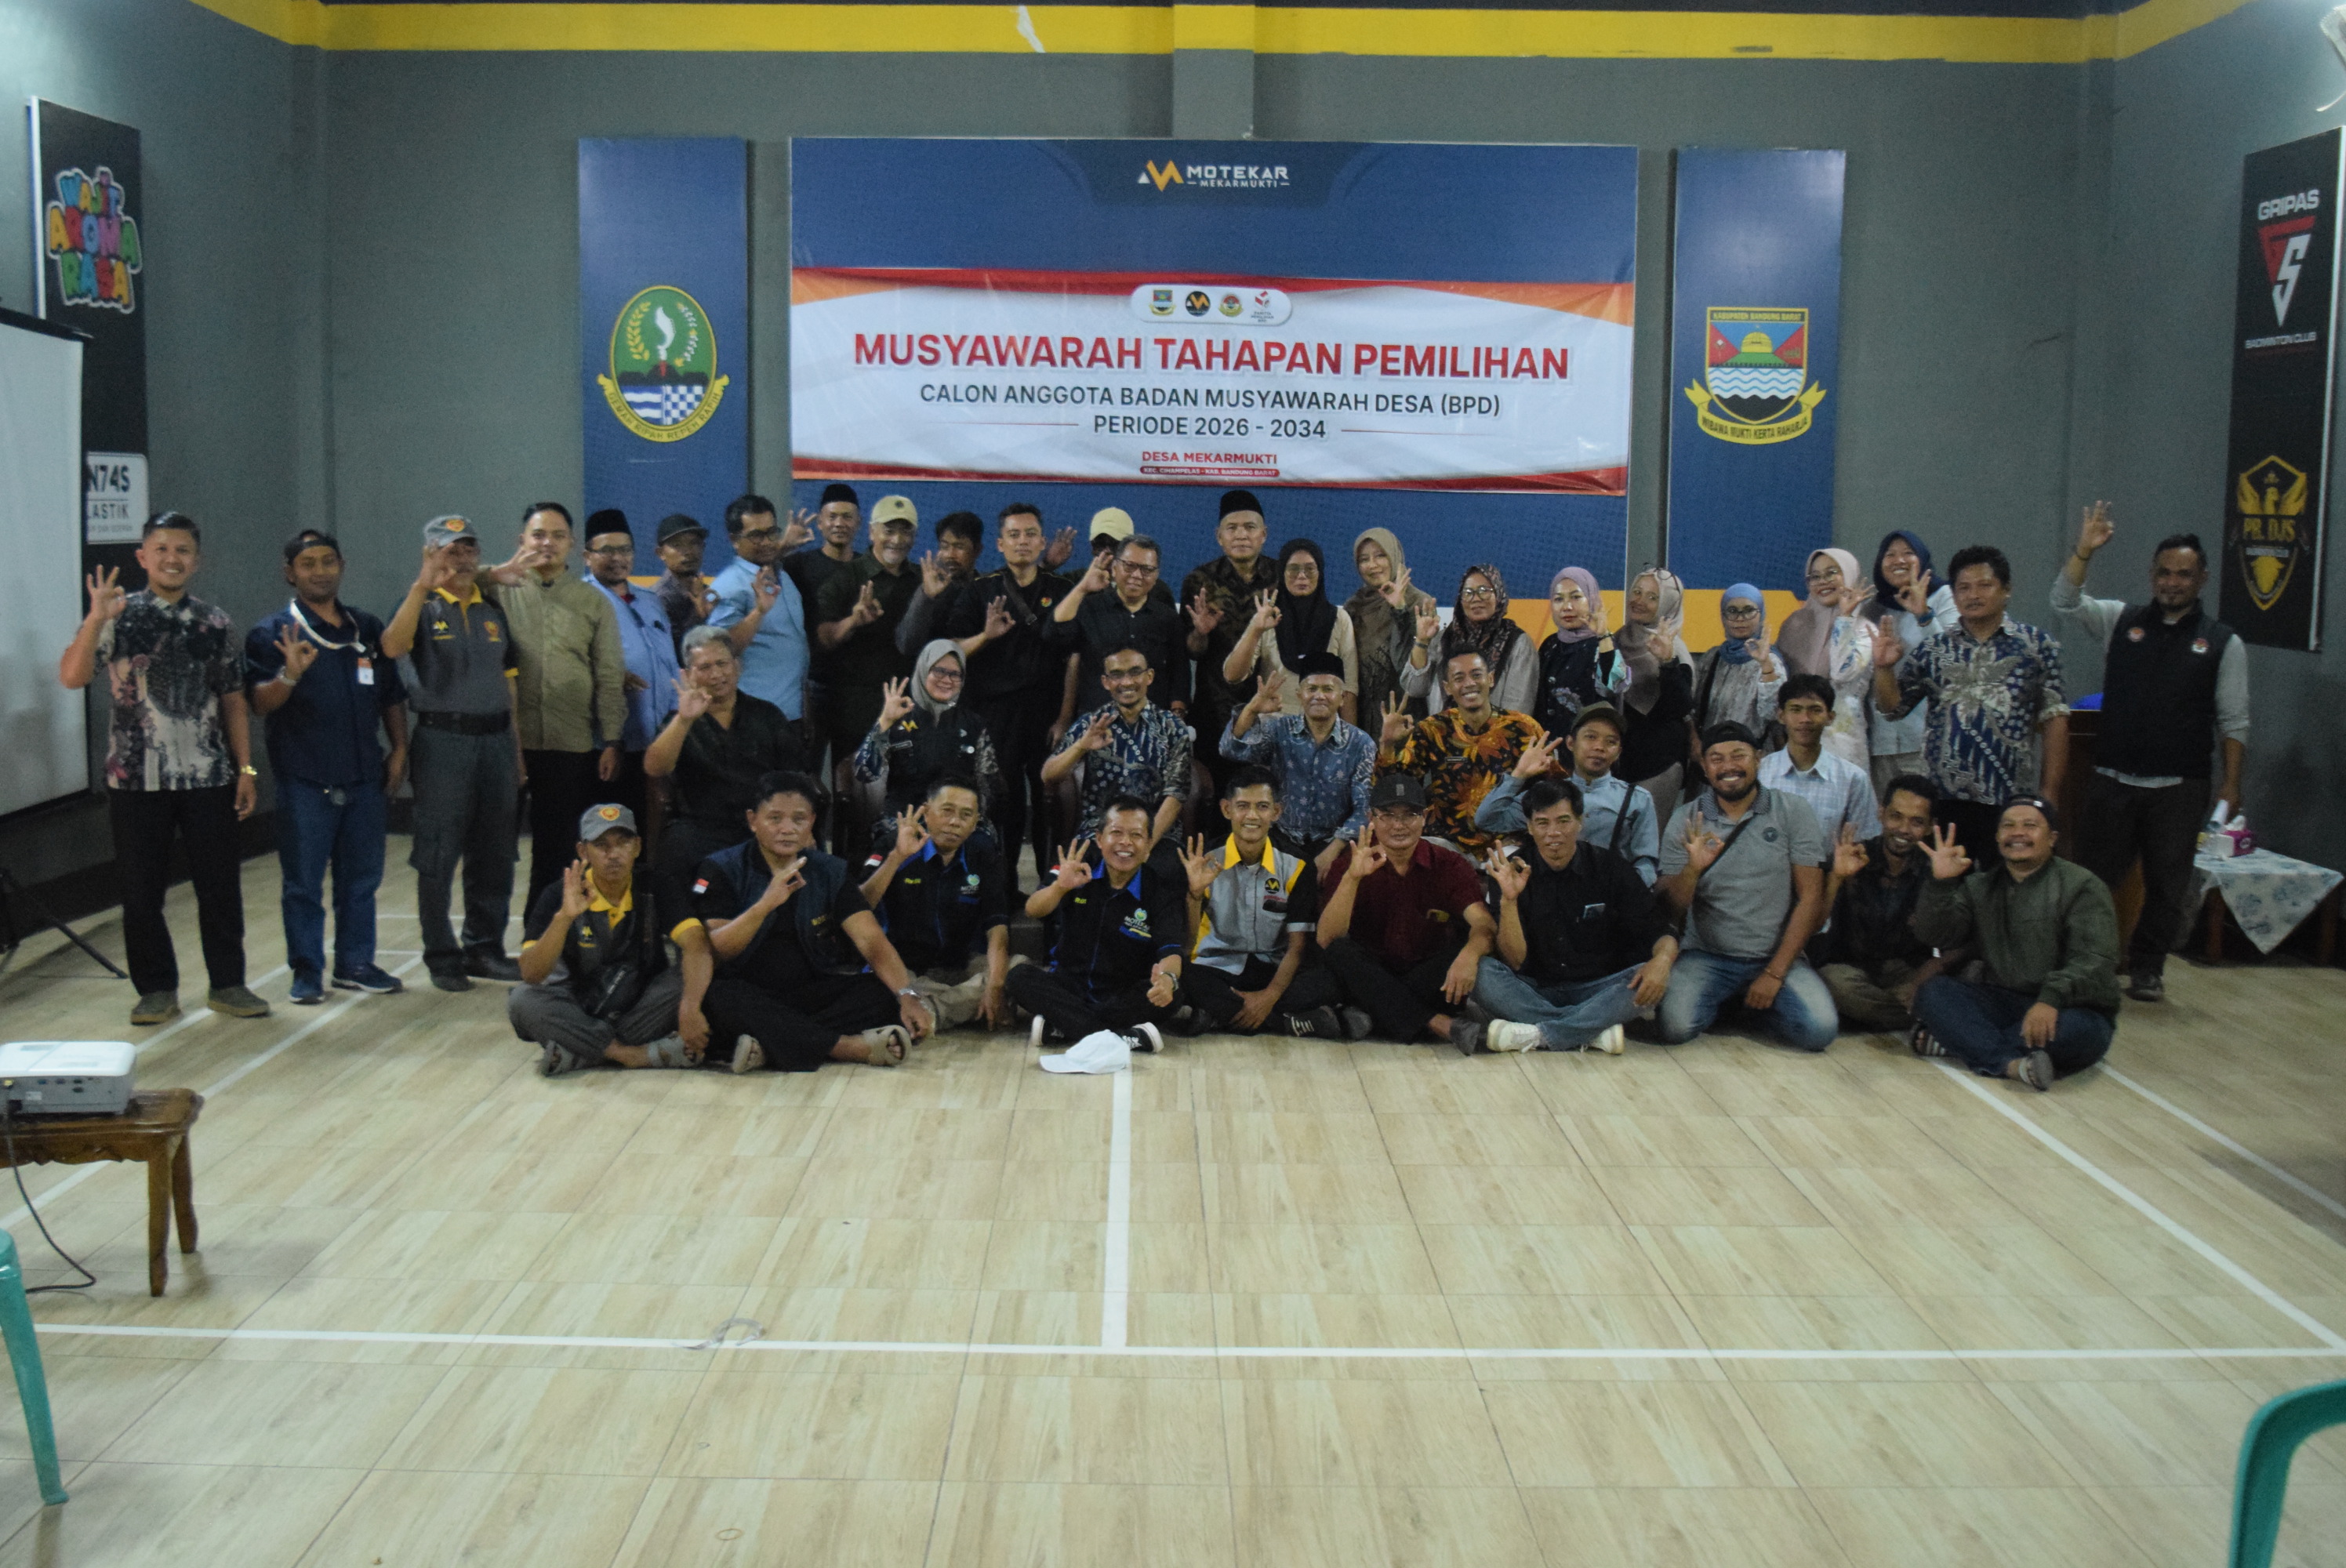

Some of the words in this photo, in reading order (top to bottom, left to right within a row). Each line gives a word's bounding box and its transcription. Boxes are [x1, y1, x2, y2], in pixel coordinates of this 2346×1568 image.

[1186, 165, 1289, 180] MOTEKAR
[1200, 180, 1277, 188] MEKARMUKTI
[2257, 189, 2319, 220] GRIPAS
[50, 205, 139, 267] AROMA
[60, 251, 129, 305] RASA
[855, 333, 1142, 368] MUSYAWARAH
[1154, 338, 1342, 372] TAHAPAN
[1354, 343, 1568, 379] PEMILIHAN
[921, 384, 997, 403] CALON
[1004, 385, 1113, 405] ANGGOTA
[1121, 388, 1198, 407] BADAN
[1206, 389, 1368, 412] MUSYAWARAH
[1375, 394, 1434, 414] DESA
[1441, 394, 1501, 417] (BPD)
[1095, 416, 1188, 435] PERIODE
[1194, 418, 1249, 437] 2026
[1270, 419, 1326, 438] 2034
[1753, 427, 1774, 439] KERTA
[1142, 451, 1179, 462] DESA
[1184, 452, 1277, 464] MEKARMUKTI
